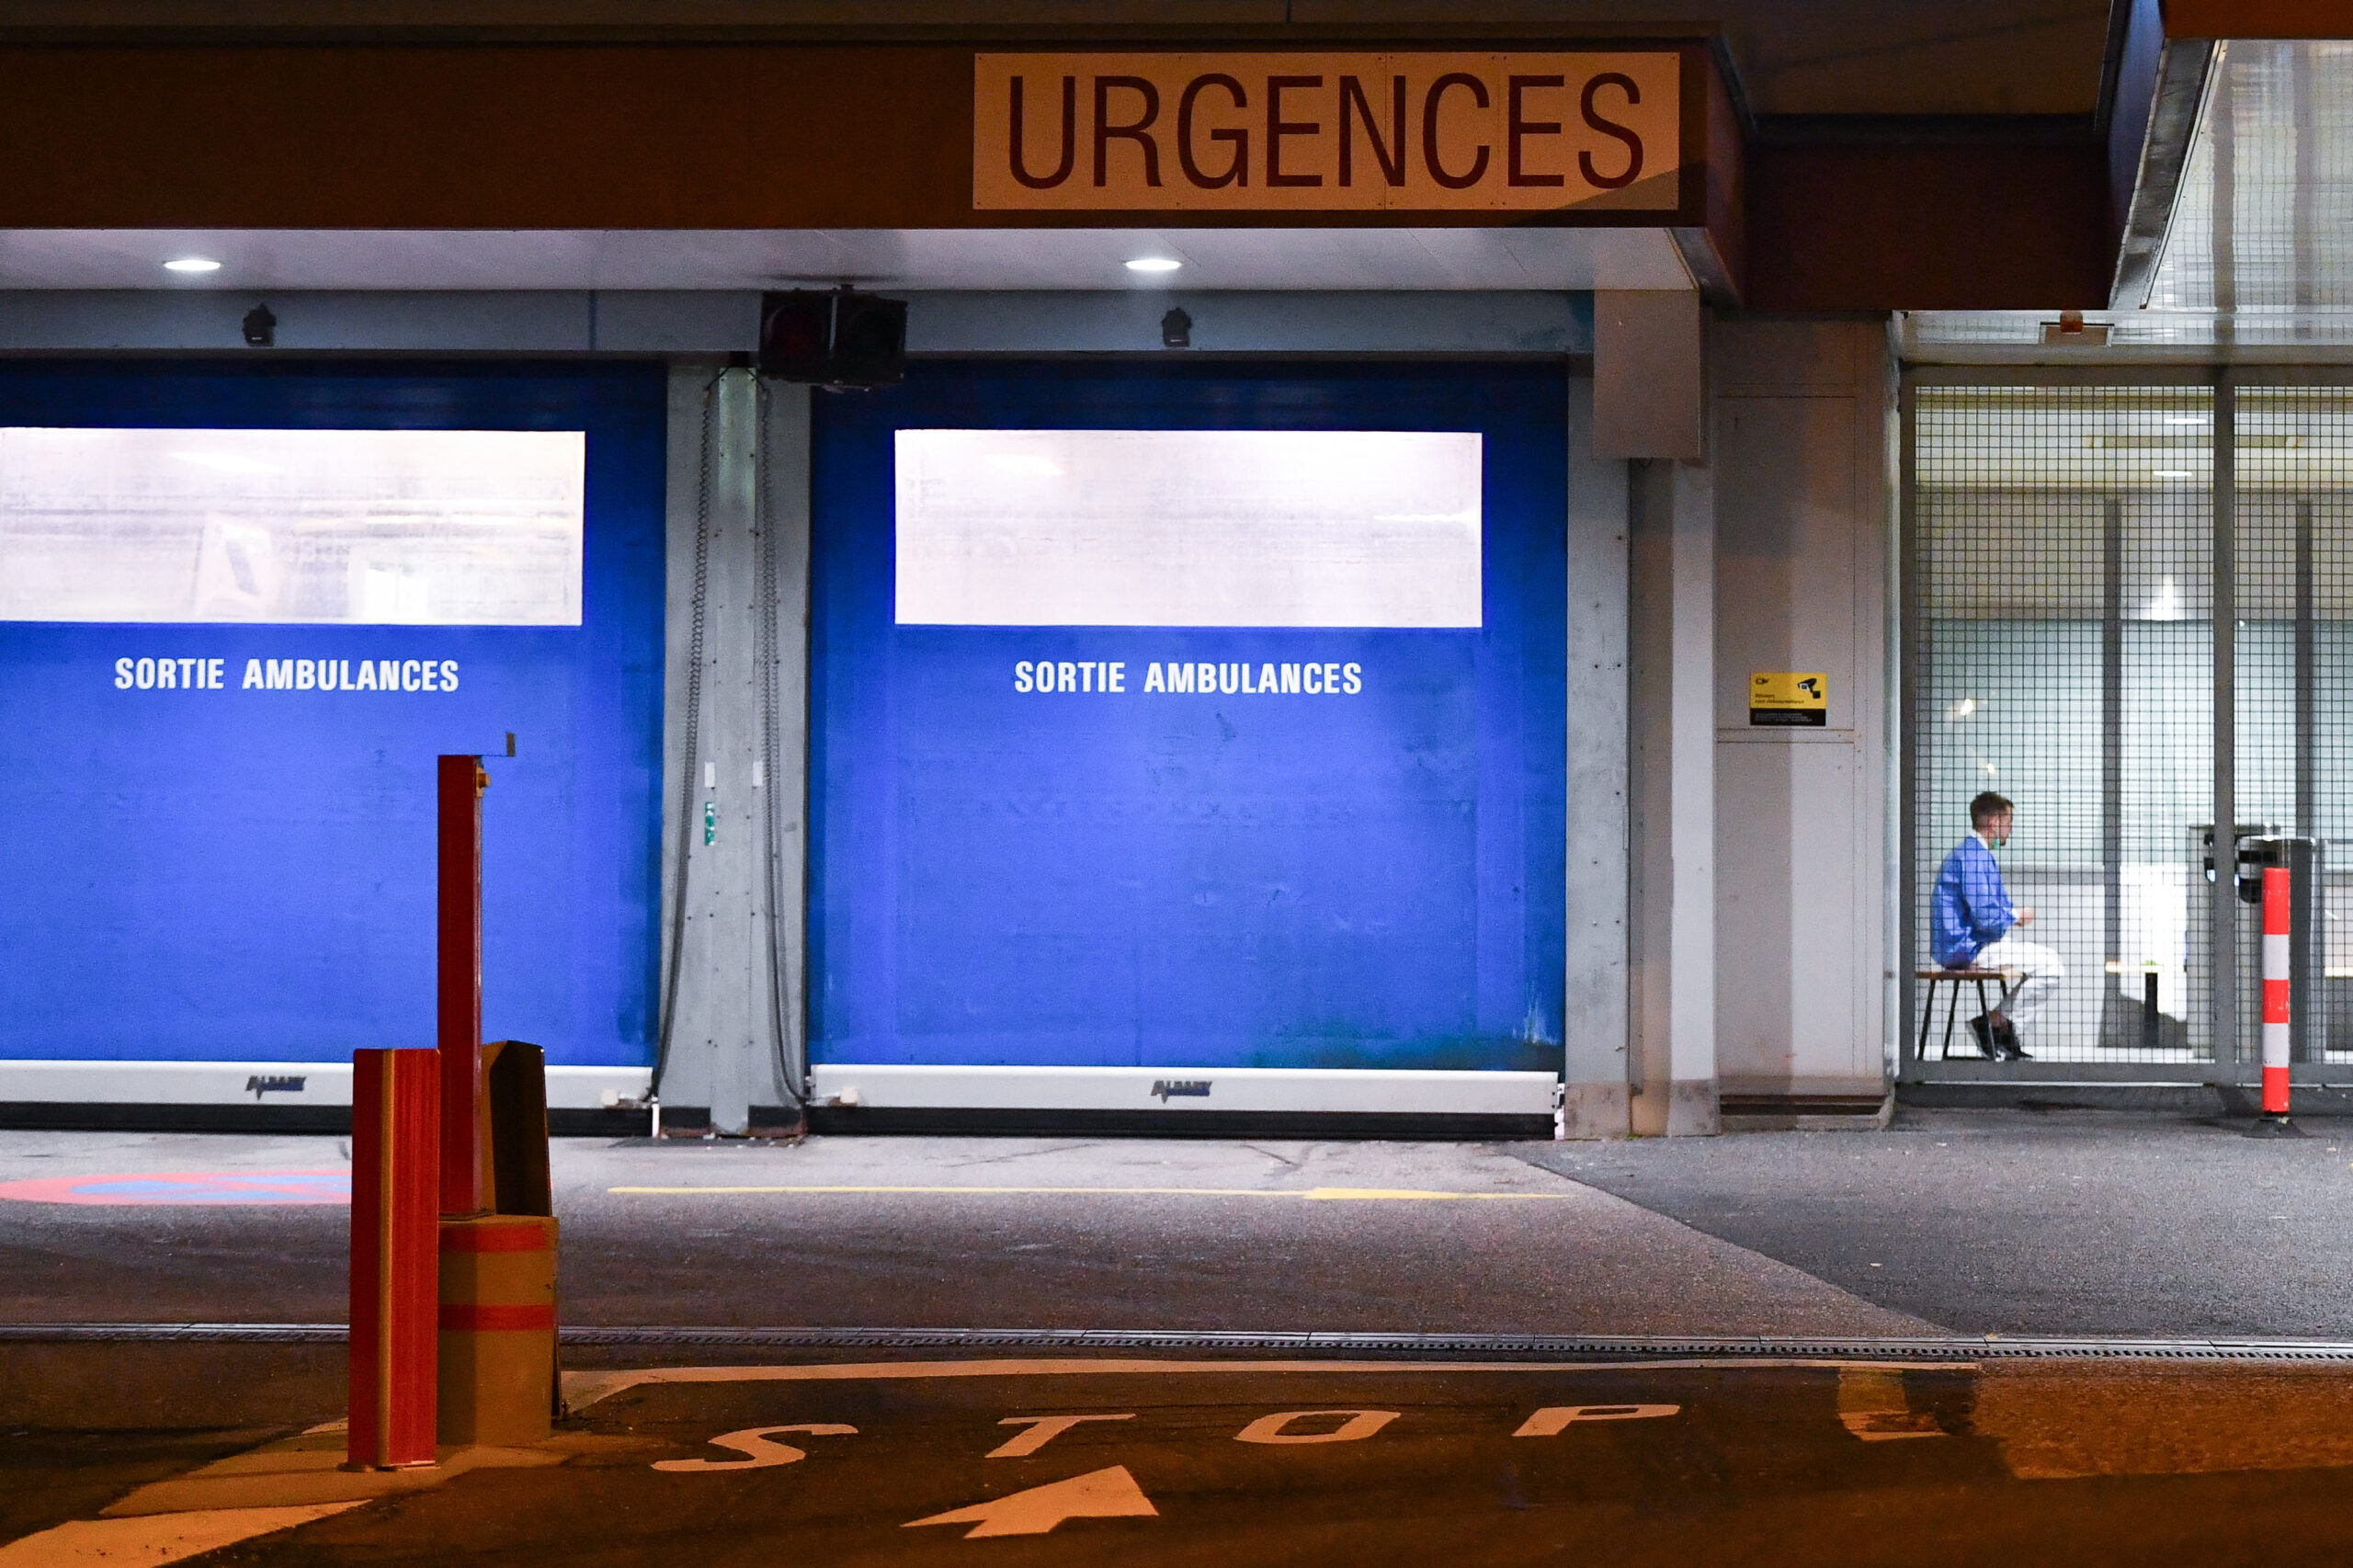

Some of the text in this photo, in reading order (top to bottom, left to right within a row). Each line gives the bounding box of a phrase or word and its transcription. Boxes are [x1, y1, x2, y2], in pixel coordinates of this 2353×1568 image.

[1008, 72, 1644, 189] URGENCES
[115, 657, 460, 692] SORTIE AMBULANCES
[1015, 661, 1362, 695] SORTIE AMBULANCES
[650, 1403, 1680, 1471] STOP
